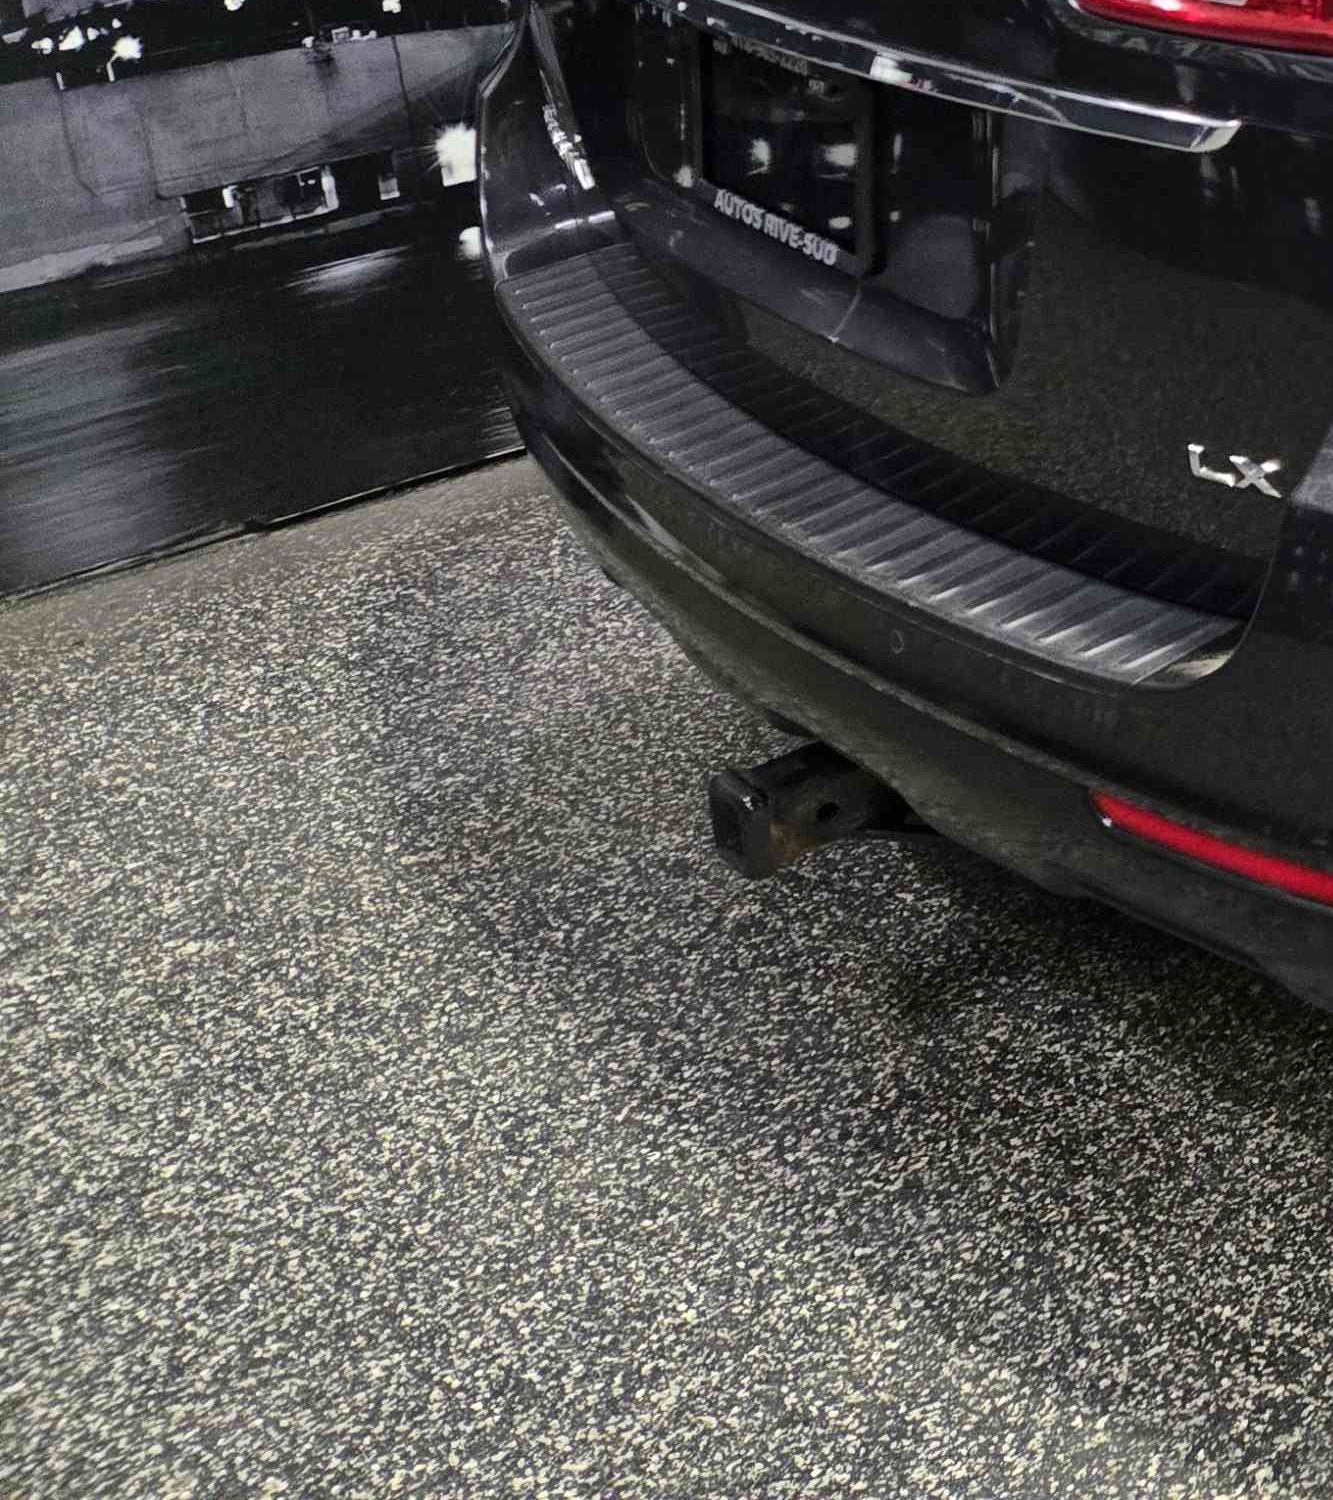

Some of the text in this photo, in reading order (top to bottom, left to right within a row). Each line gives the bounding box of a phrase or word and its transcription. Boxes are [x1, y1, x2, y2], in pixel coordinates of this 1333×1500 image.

[713, 188, 841, 266] AUTOS RIVE-SUD
[1187, 443, 1283, 498] LX
